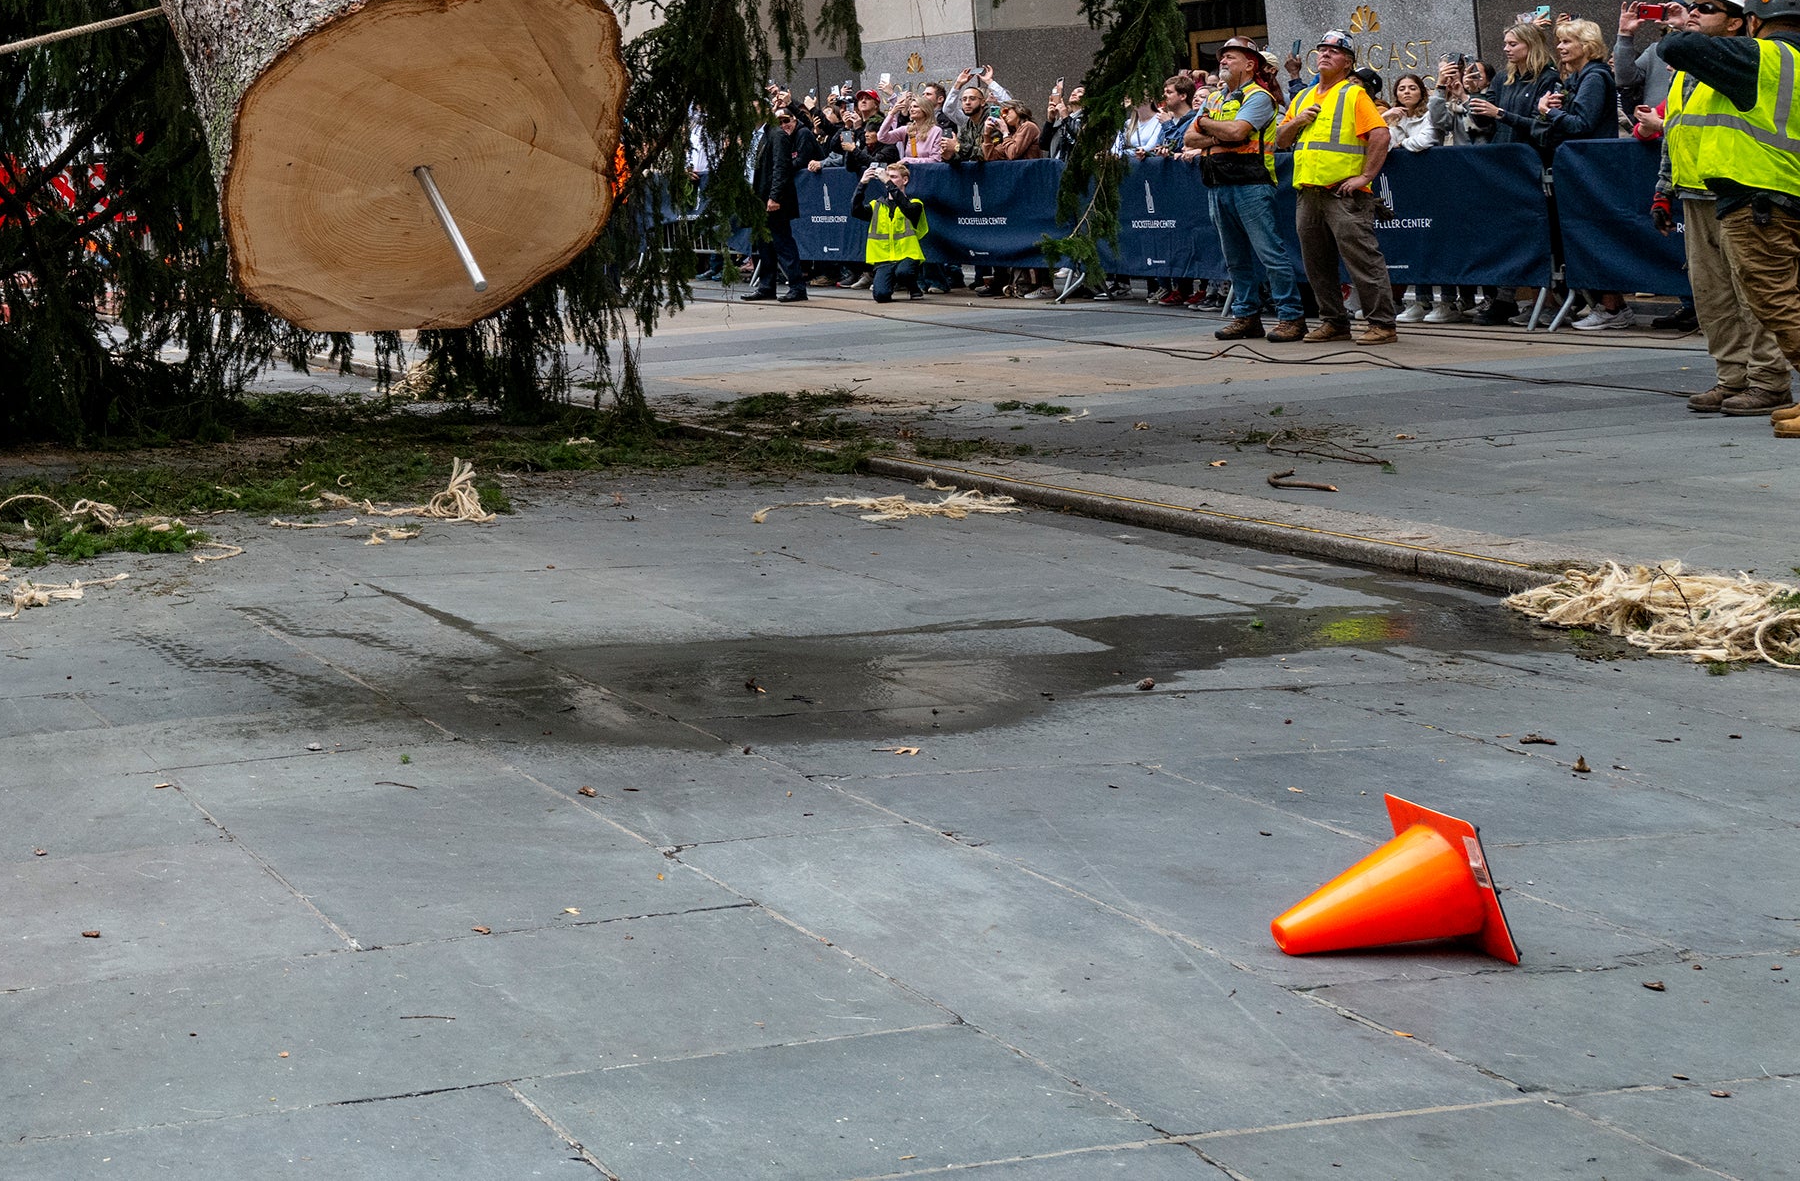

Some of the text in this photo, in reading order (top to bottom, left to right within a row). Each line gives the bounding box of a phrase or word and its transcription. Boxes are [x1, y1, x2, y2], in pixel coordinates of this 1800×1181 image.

[1306, 40, 1432, 75] CCAST
[957, 217, 1007, 225] ROCKEFELLER CENTER
[1131, 219, 1176, 228] ROCKEFELLER CENTER
[1401, 218, 1432, 228] CENTER
